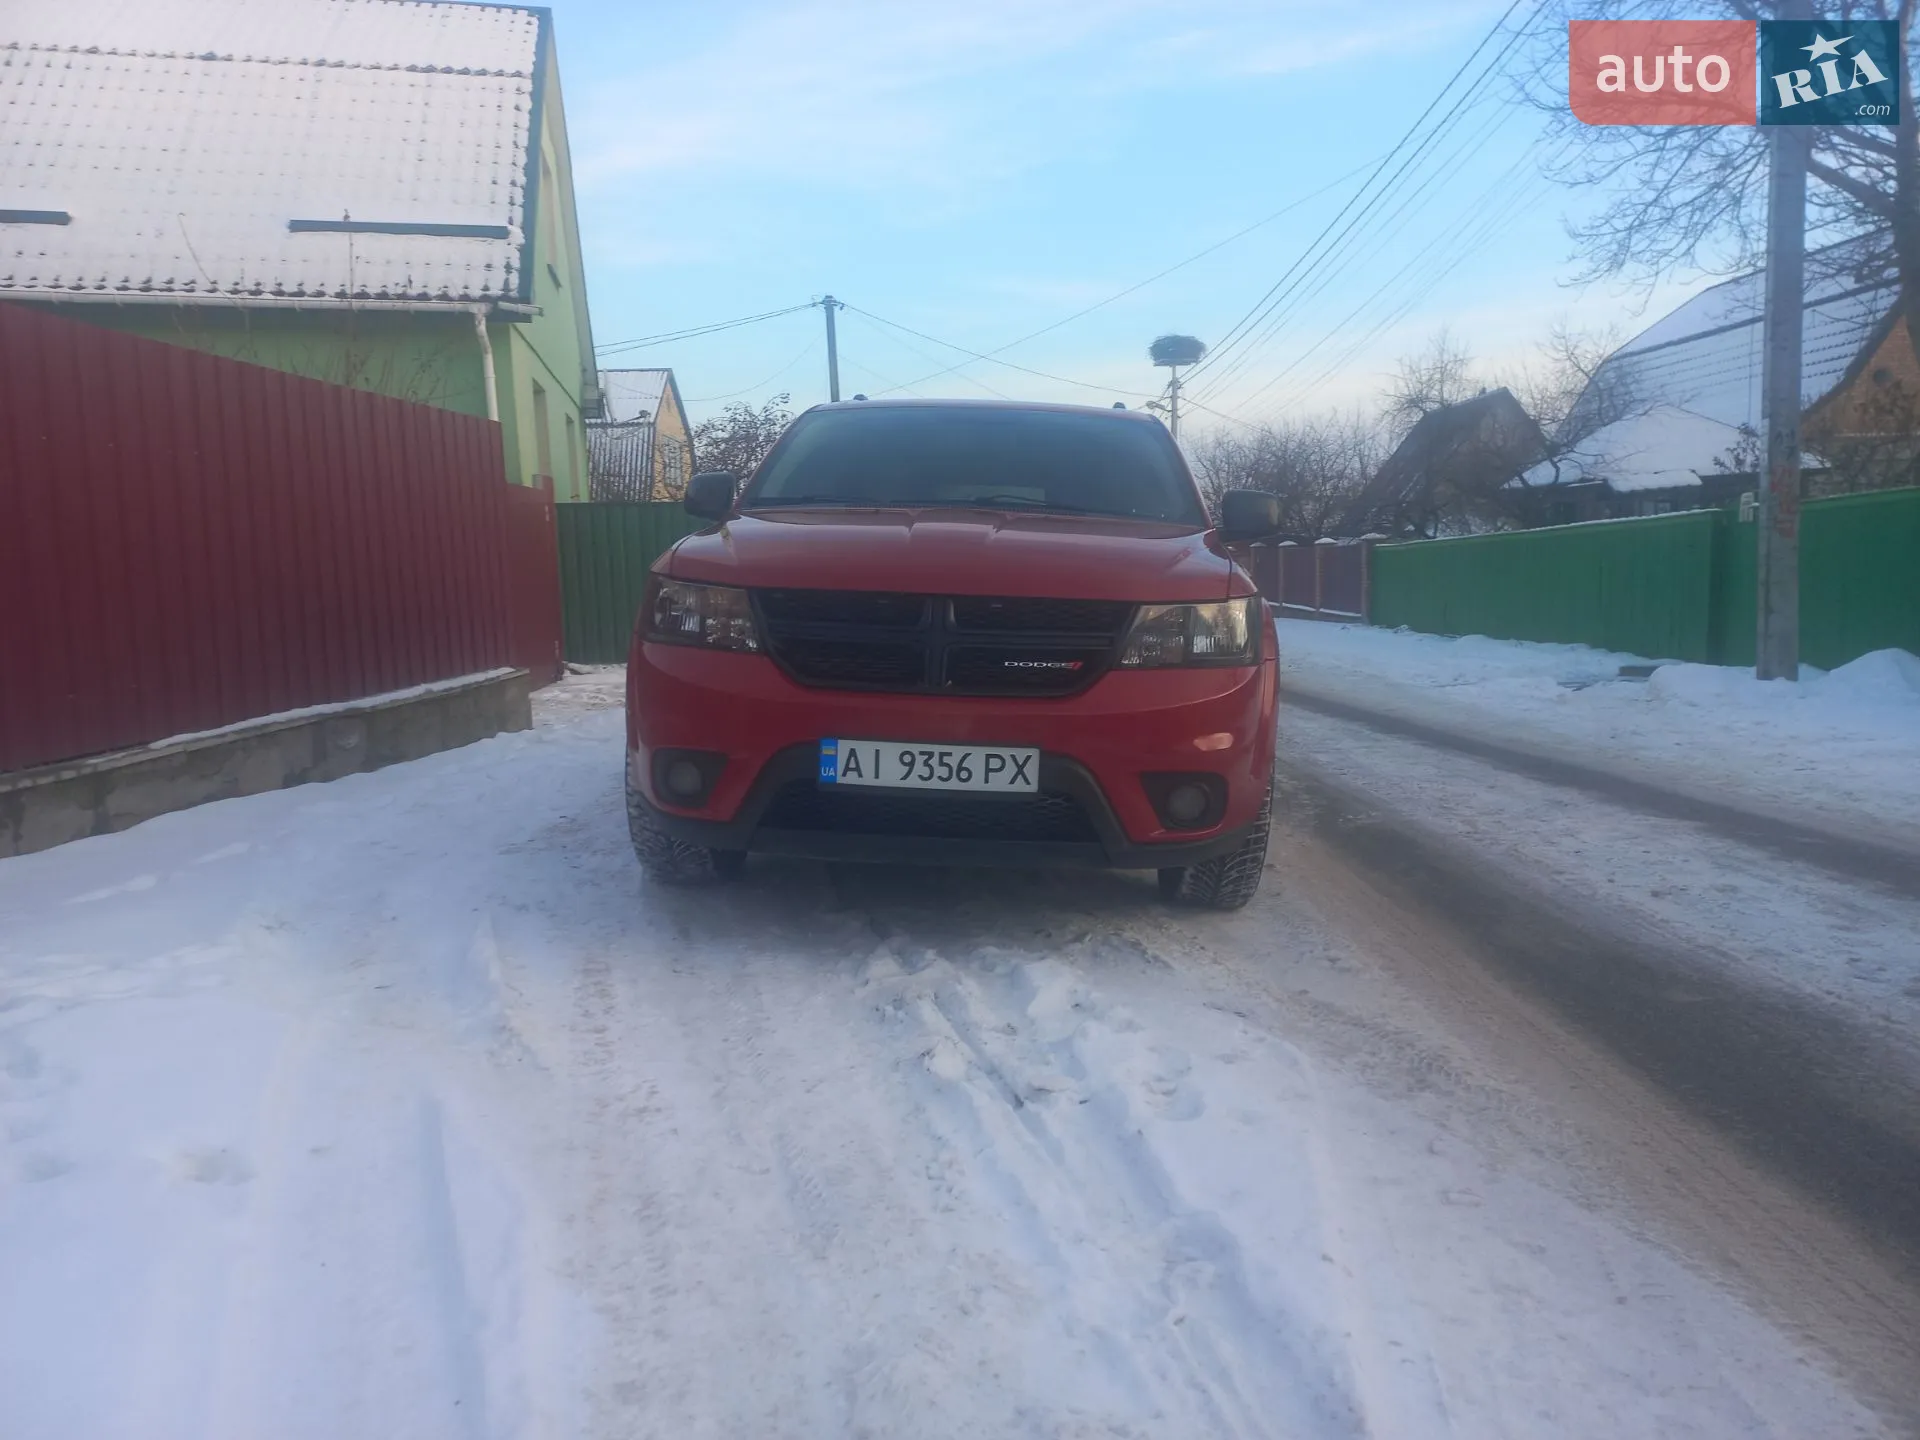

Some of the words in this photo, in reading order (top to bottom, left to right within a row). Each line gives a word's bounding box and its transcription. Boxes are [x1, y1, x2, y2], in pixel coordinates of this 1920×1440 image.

[1004, 661, 1074, 669] DODGE
[821, 766, 835, 777] UA
[841, 747, 880, 780] AI
[898, 750, 974, 783] 9356
[983, 753, 1033, 786] PX
